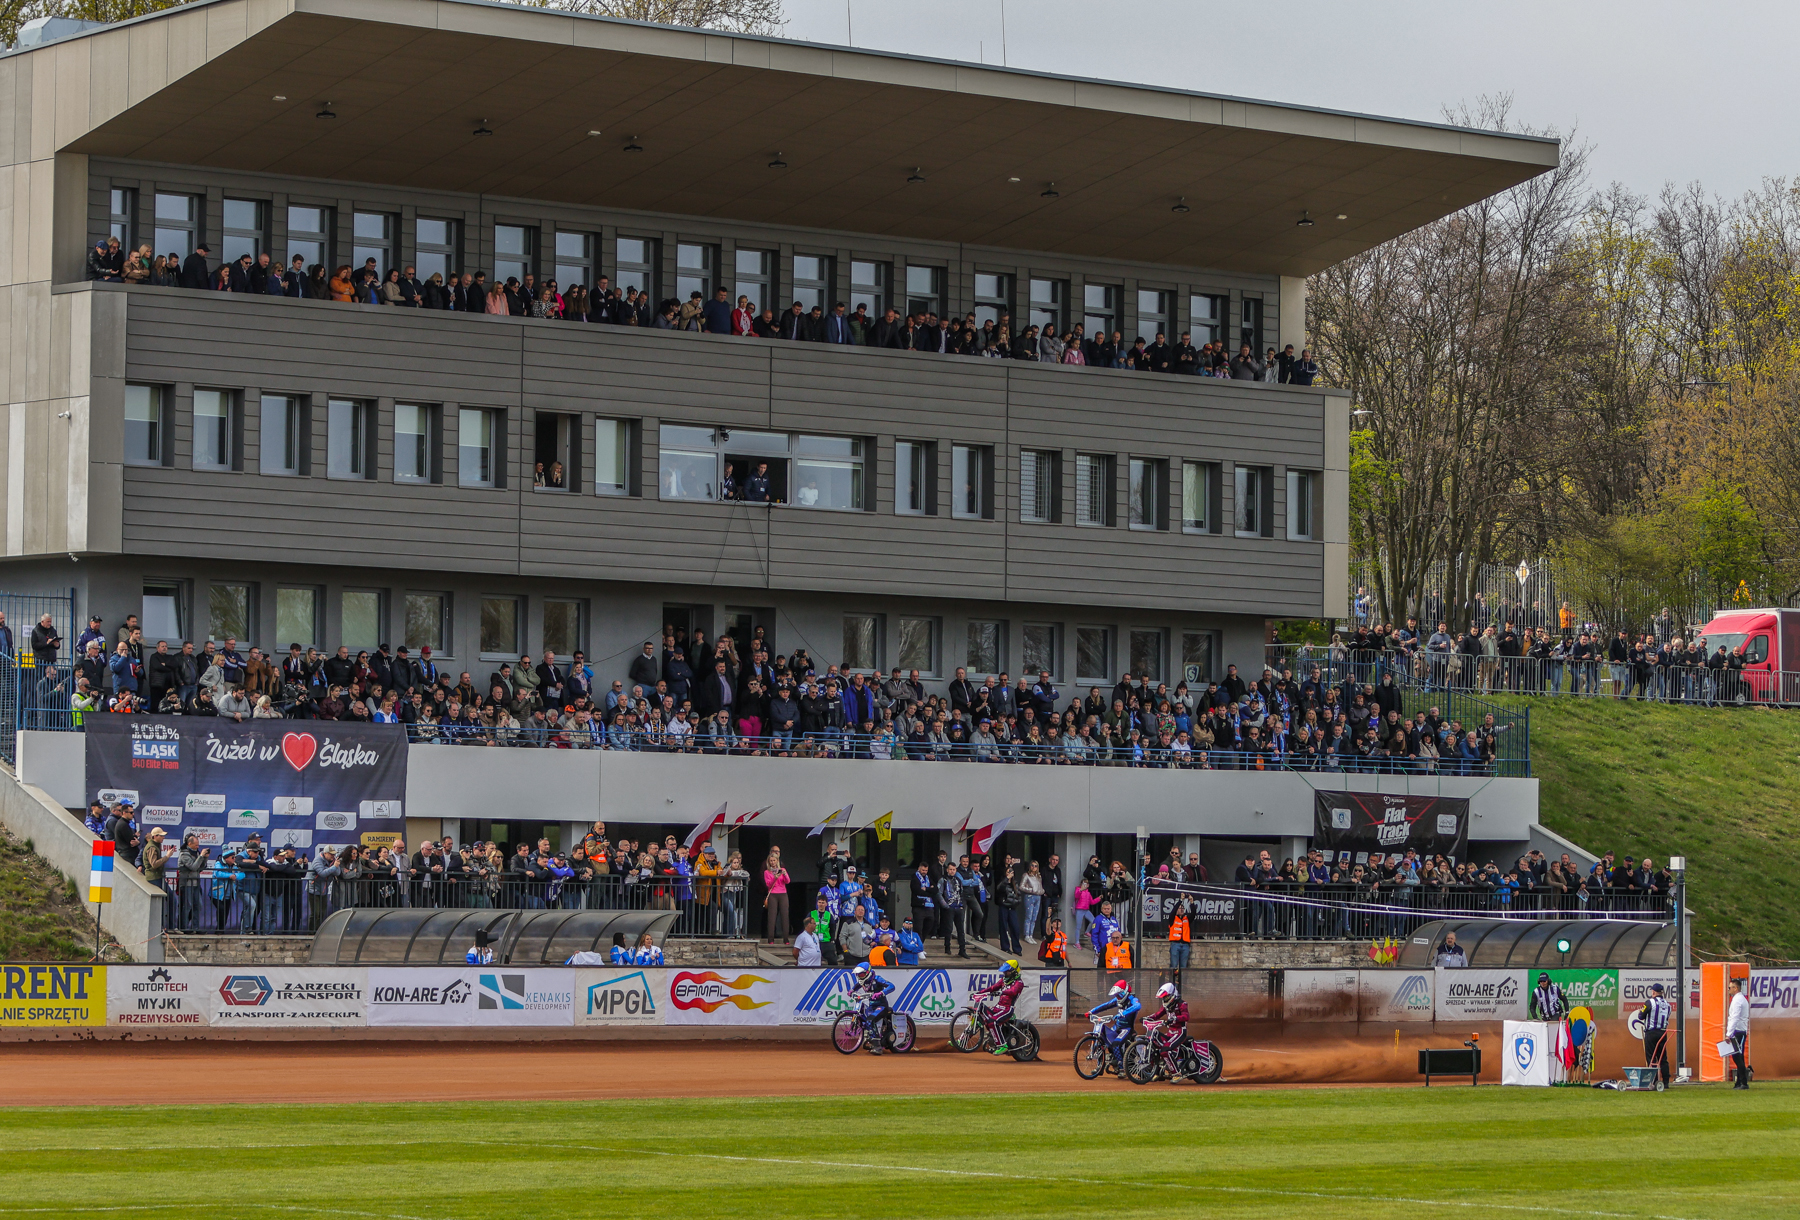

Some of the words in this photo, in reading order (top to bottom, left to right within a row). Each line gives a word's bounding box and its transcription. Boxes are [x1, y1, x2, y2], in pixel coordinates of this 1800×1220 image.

[131, 722, 180, 740] 100%
[133, 740, 178, 759] ŚLĄSK
[206, 732, 256, 764] Żużel
[260, 745, 280, 761] w
[319, 737, 379, 769] Śląska
[145, 760, 161, 769] Elite
[162, 760, 180, 770] Team
[146, 809, 179, 817] MOTOKRIS
[1383, 807, 1407, 824] Flat
[1376, 821, 1411, 840] Track
[0, 967, 93, 999] RENT
[132, 983, 188, 992] ROTORTECH
[1040, 980, 1053, 997] psb
[1449, 983, 1495, 997] KON-ARE
[277, 990, 361, 1000] TRANSPORT
[373, 986, 440, 1002] KON-ARE
[525, 992, 571, 1003] XENAKIS
[676, 985, 730, 998] BAMAL
[138, 998, 181, 1010] MYJKI
[594, 989, 656, 1015] MPGL
[28, 1008, 89, 1023] SPRZĘTU
[1463, 1007, 1497, 1015] www.konare.pl
[119, 1014, 200, 1024] PRZEMYSŁOWE
